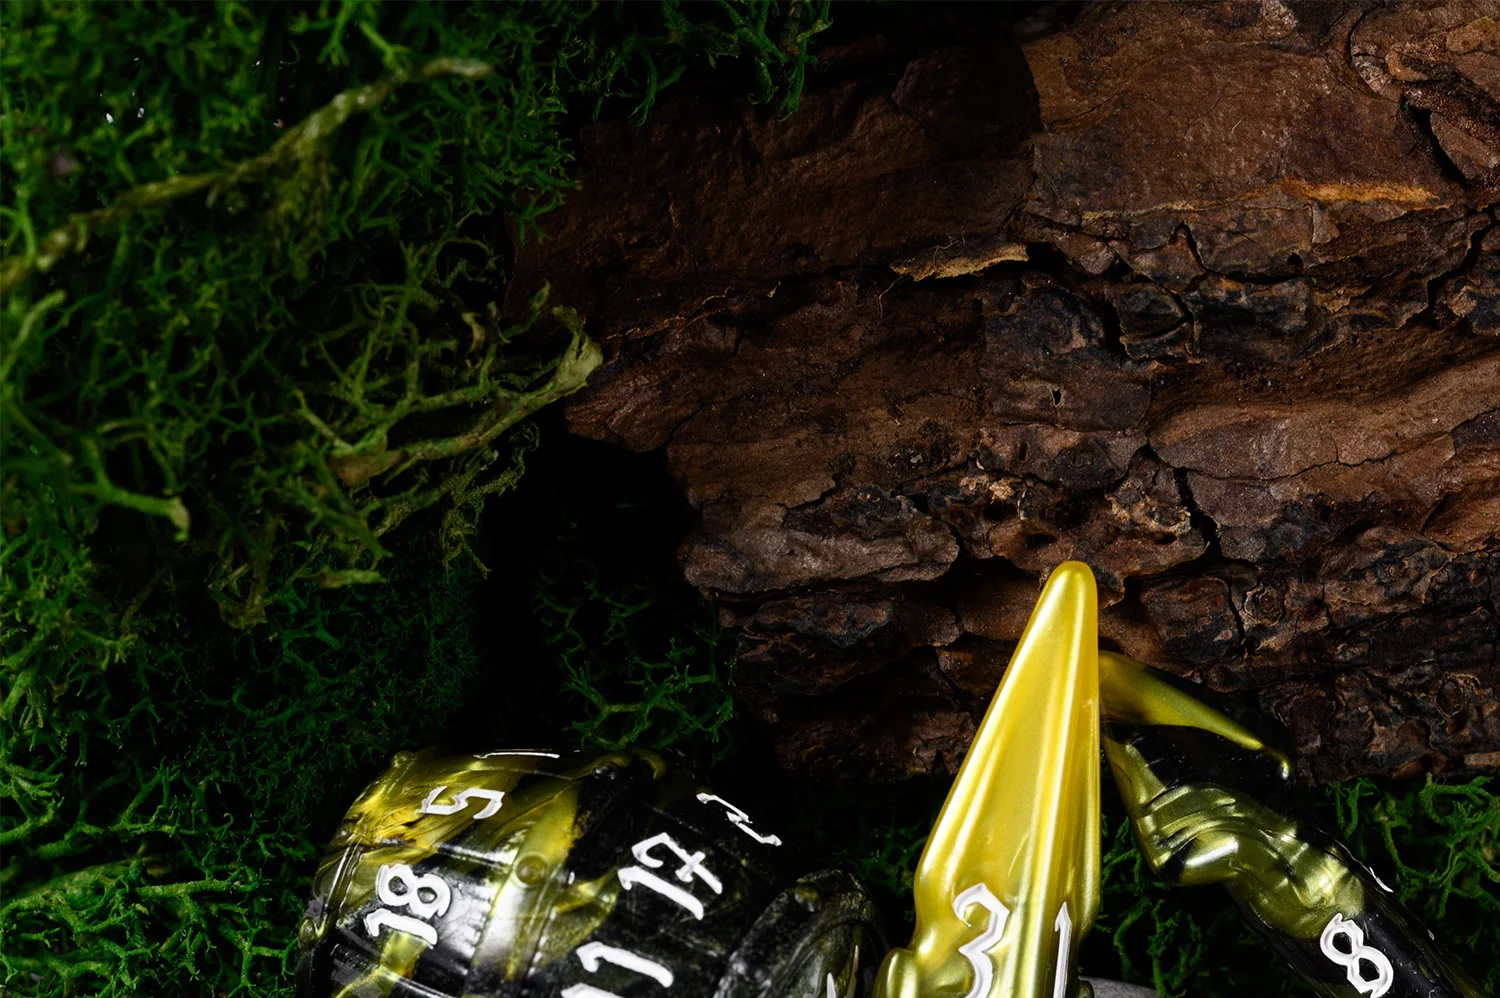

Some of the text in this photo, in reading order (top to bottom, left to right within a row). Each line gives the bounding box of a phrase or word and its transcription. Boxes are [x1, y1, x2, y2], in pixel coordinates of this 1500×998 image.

[418, 784, 506, 823] 5
[364, 862, 454, 948] 18
[616, 831, 726, 922] 17
